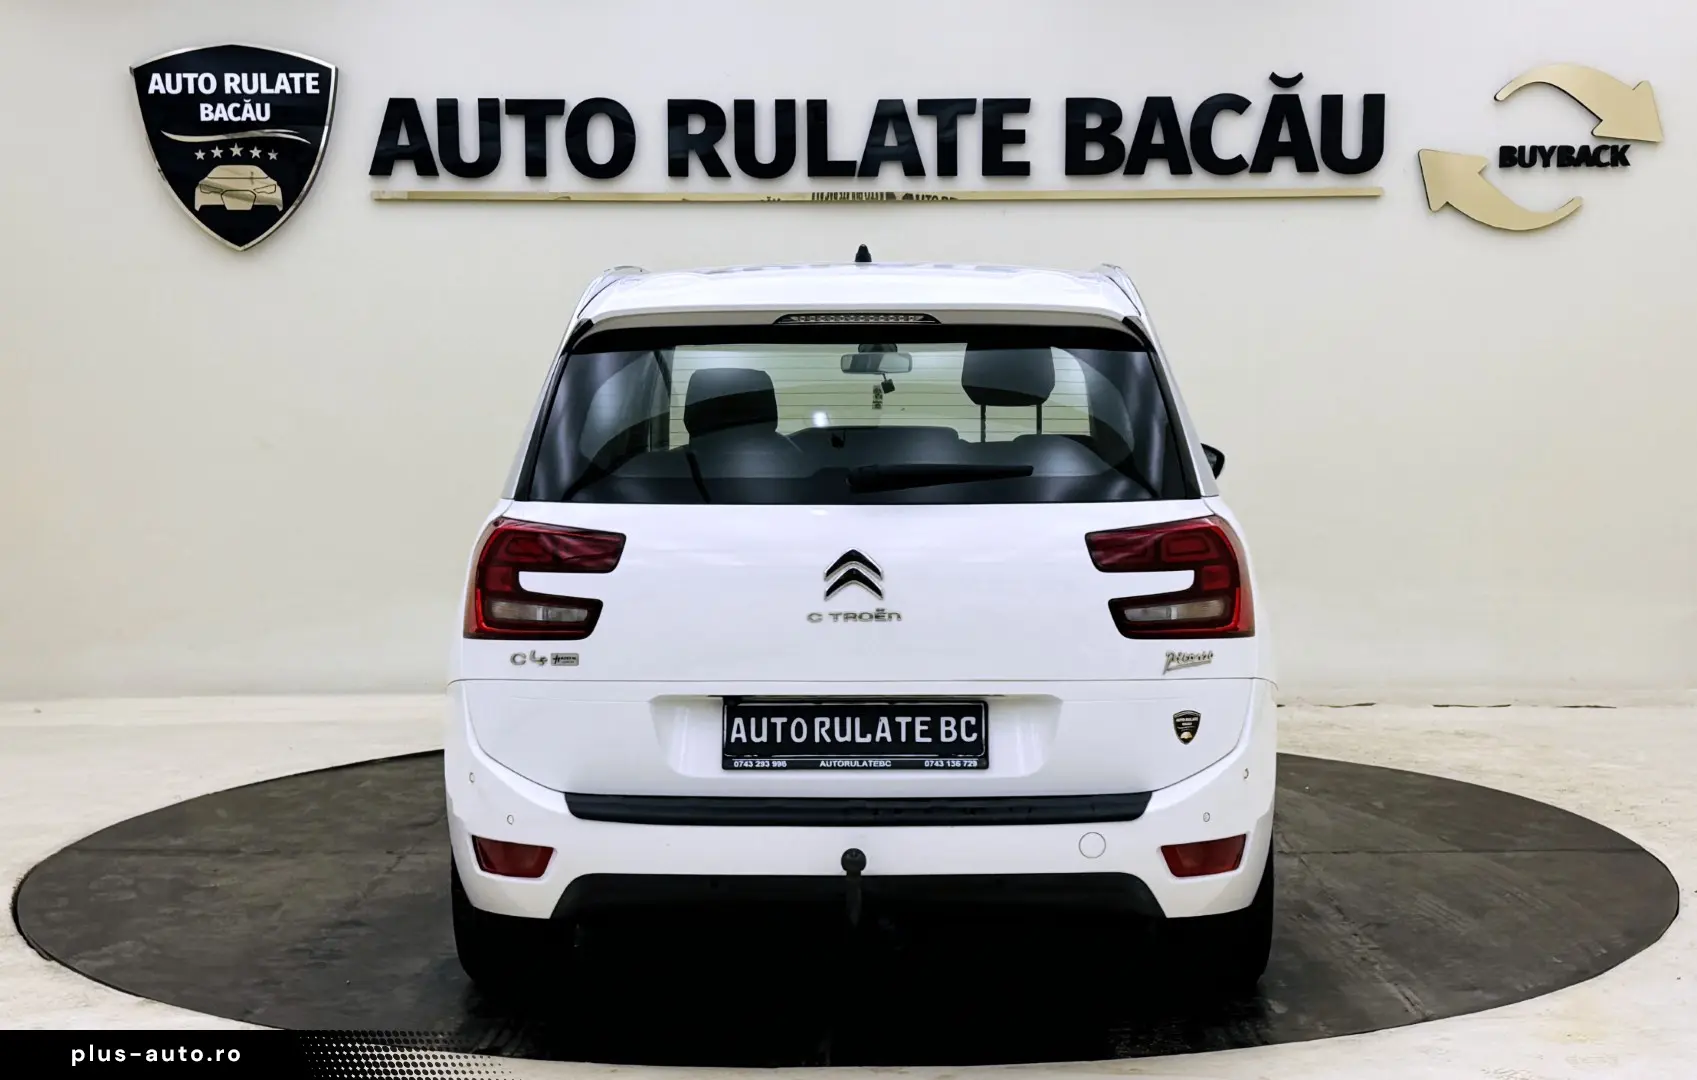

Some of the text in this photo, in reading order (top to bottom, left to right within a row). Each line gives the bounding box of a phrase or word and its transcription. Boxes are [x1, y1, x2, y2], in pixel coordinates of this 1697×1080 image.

[148, 72, 320, 95] AUTO RULATE
[199, 99, 271, 122] BACĂU
[368, 71, 1386, 180] AUTO RULATE BACĂU
[1498, 144, 1631, 169] BUYBACK
[806, 608, 903, 623] CTROËN
[730, 716, 978, 743] AUTO RULATE BC
[733, 760, 754, 768] 0743
[819, 760, 892, 768] AUTORULATEBC
[924, 760, 945, 768] 0743
